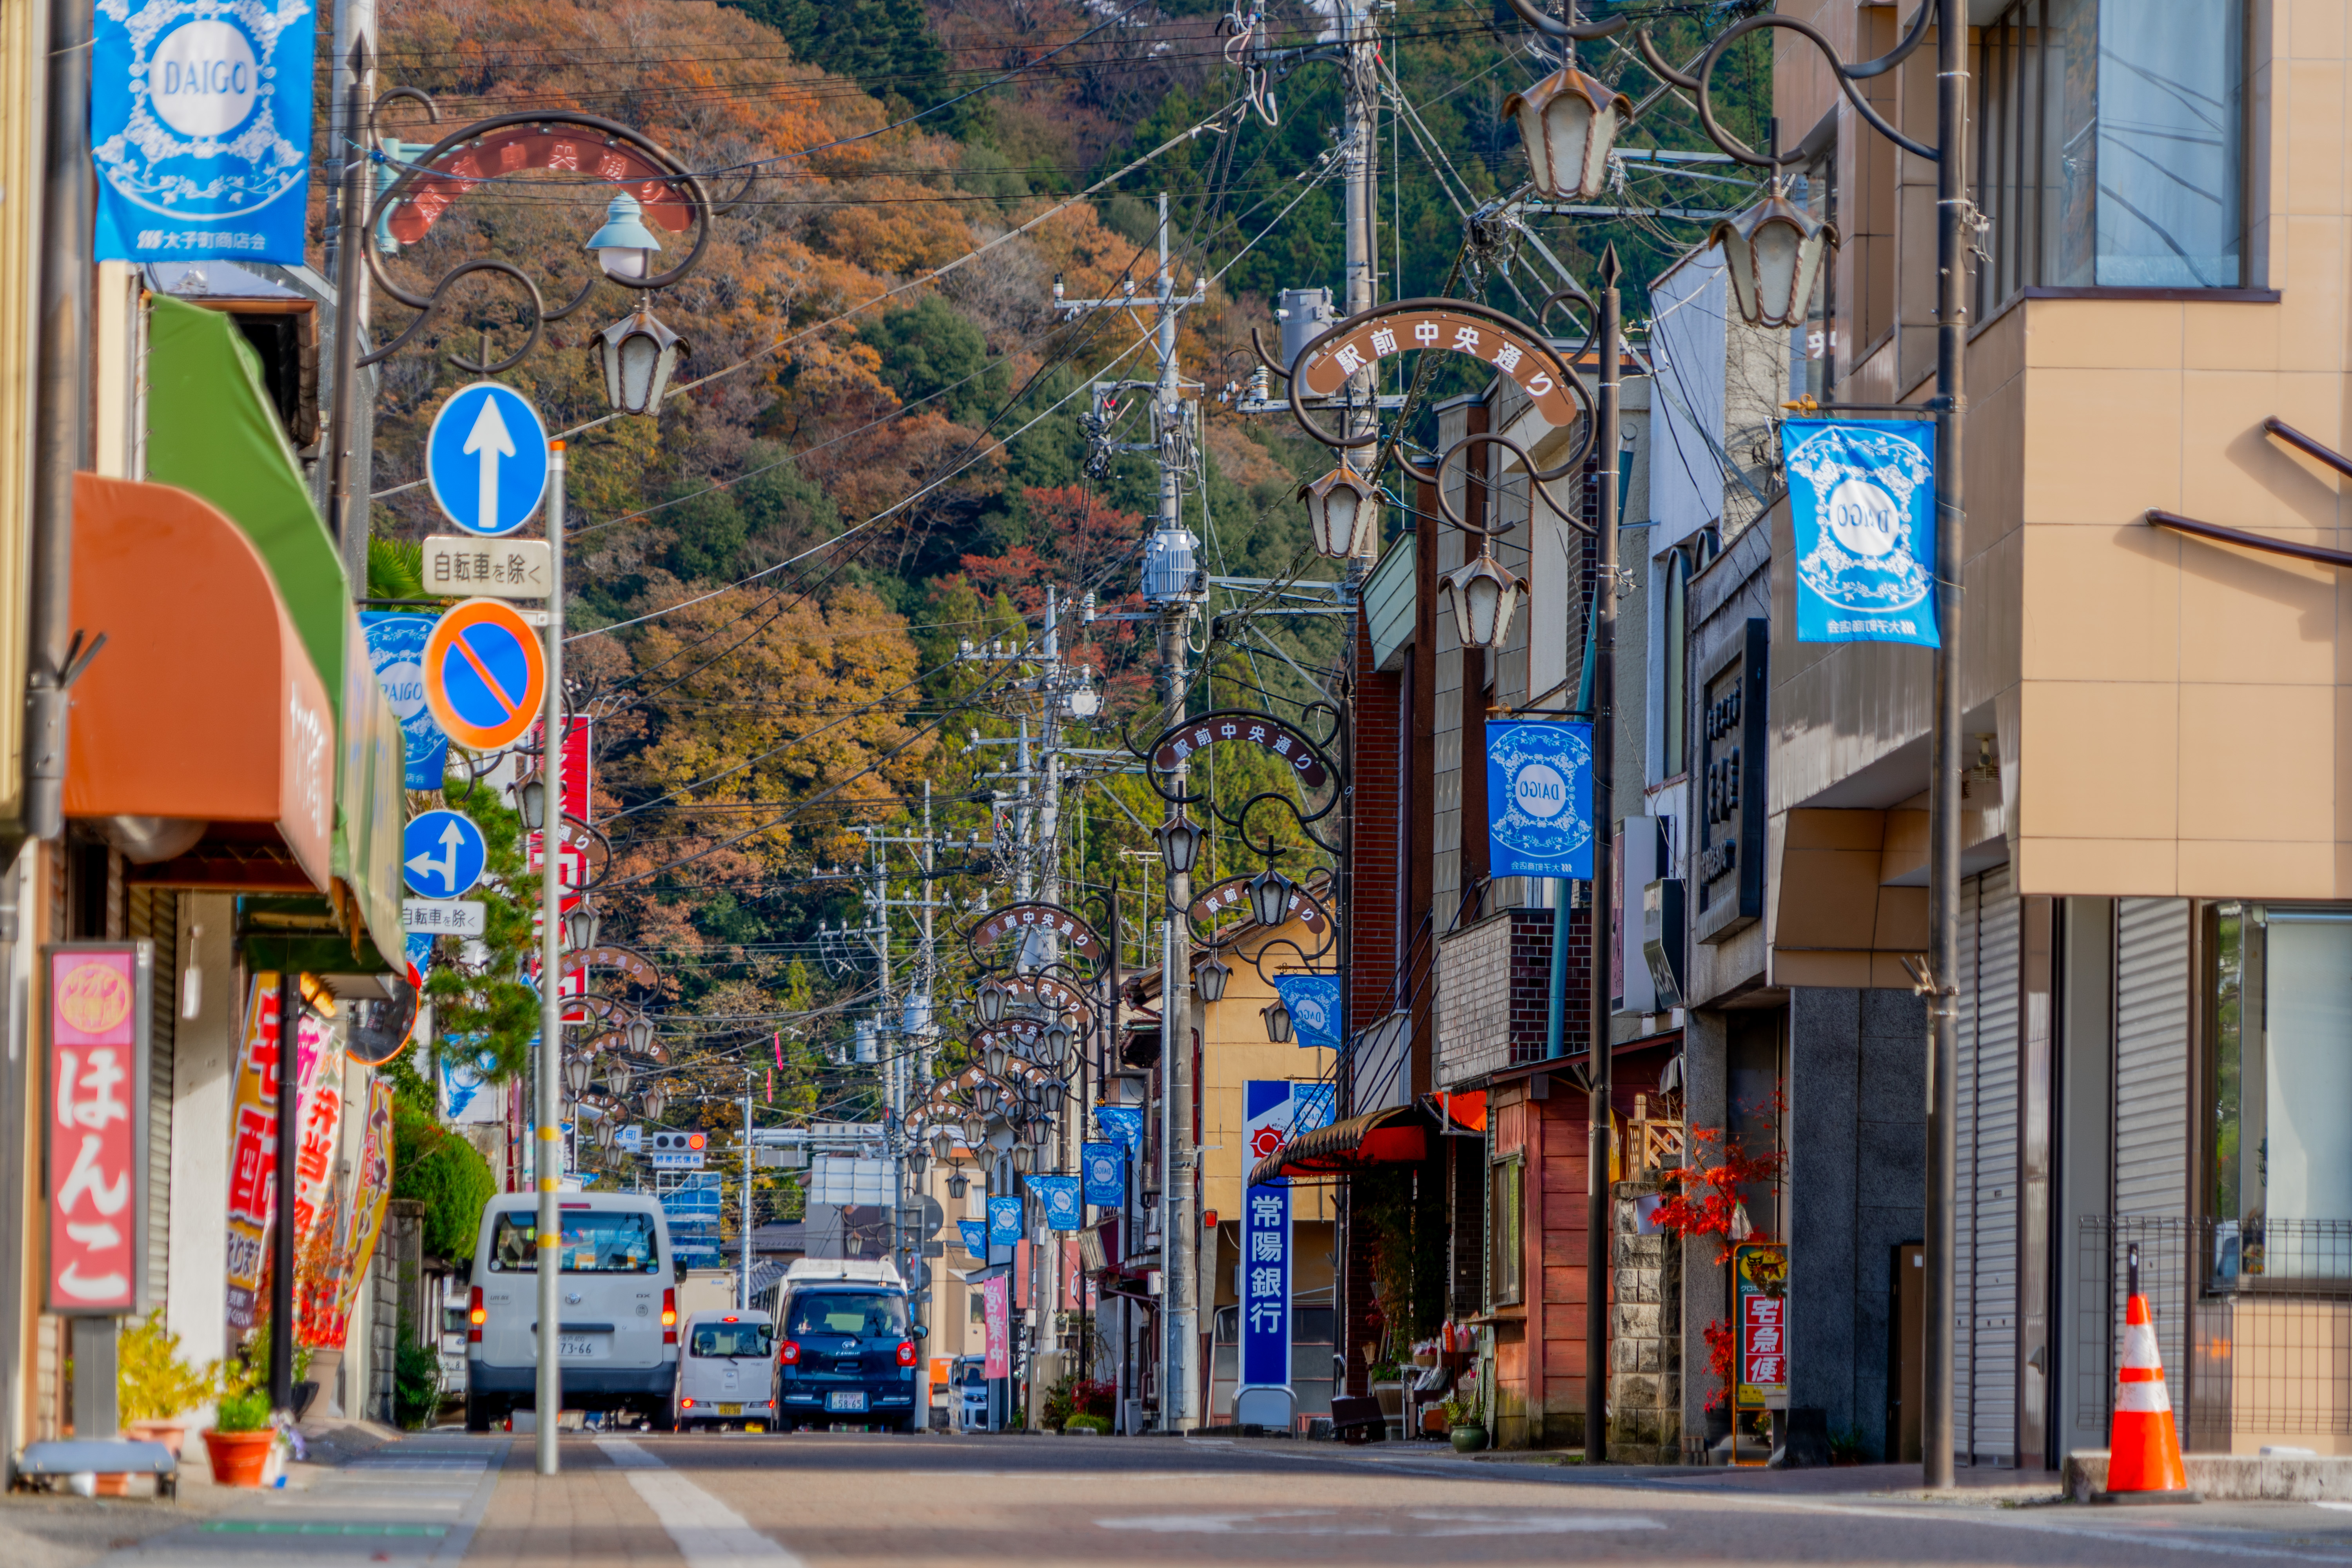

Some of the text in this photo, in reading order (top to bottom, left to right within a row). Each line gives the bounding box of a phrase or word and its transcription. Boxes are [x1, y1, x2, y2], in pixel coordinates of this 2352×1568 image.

[164, 59, 248, 95] DAIGO
[415, 140, 666, 219] 駅前中央通り
[164, 232, 265, 250] 大子町商店会
[1334, 320, 1554, 397] 駅前中央通り
[434, 552, 541, 584] 自転車を除く
[1173, 722, 1312, 769] 駅前中央通り
[403, 907, 475, 928] 自転車を除く
[987, 911, 1089, 946] 駅前中央通り
[563, 952, 643, 975] 前中央通り
[656, 1155, 701, 1164] 時差式信号
[1250, 1196, 1283, 1333] 常陽銀行
[984, 1285, 1004, 1369] 営業中
[1750, 1299, 1780, 1383] 宅急便
[561, 1343, 591, 1354] 73-66
[838, 1399, 862, 1408] 58-65
